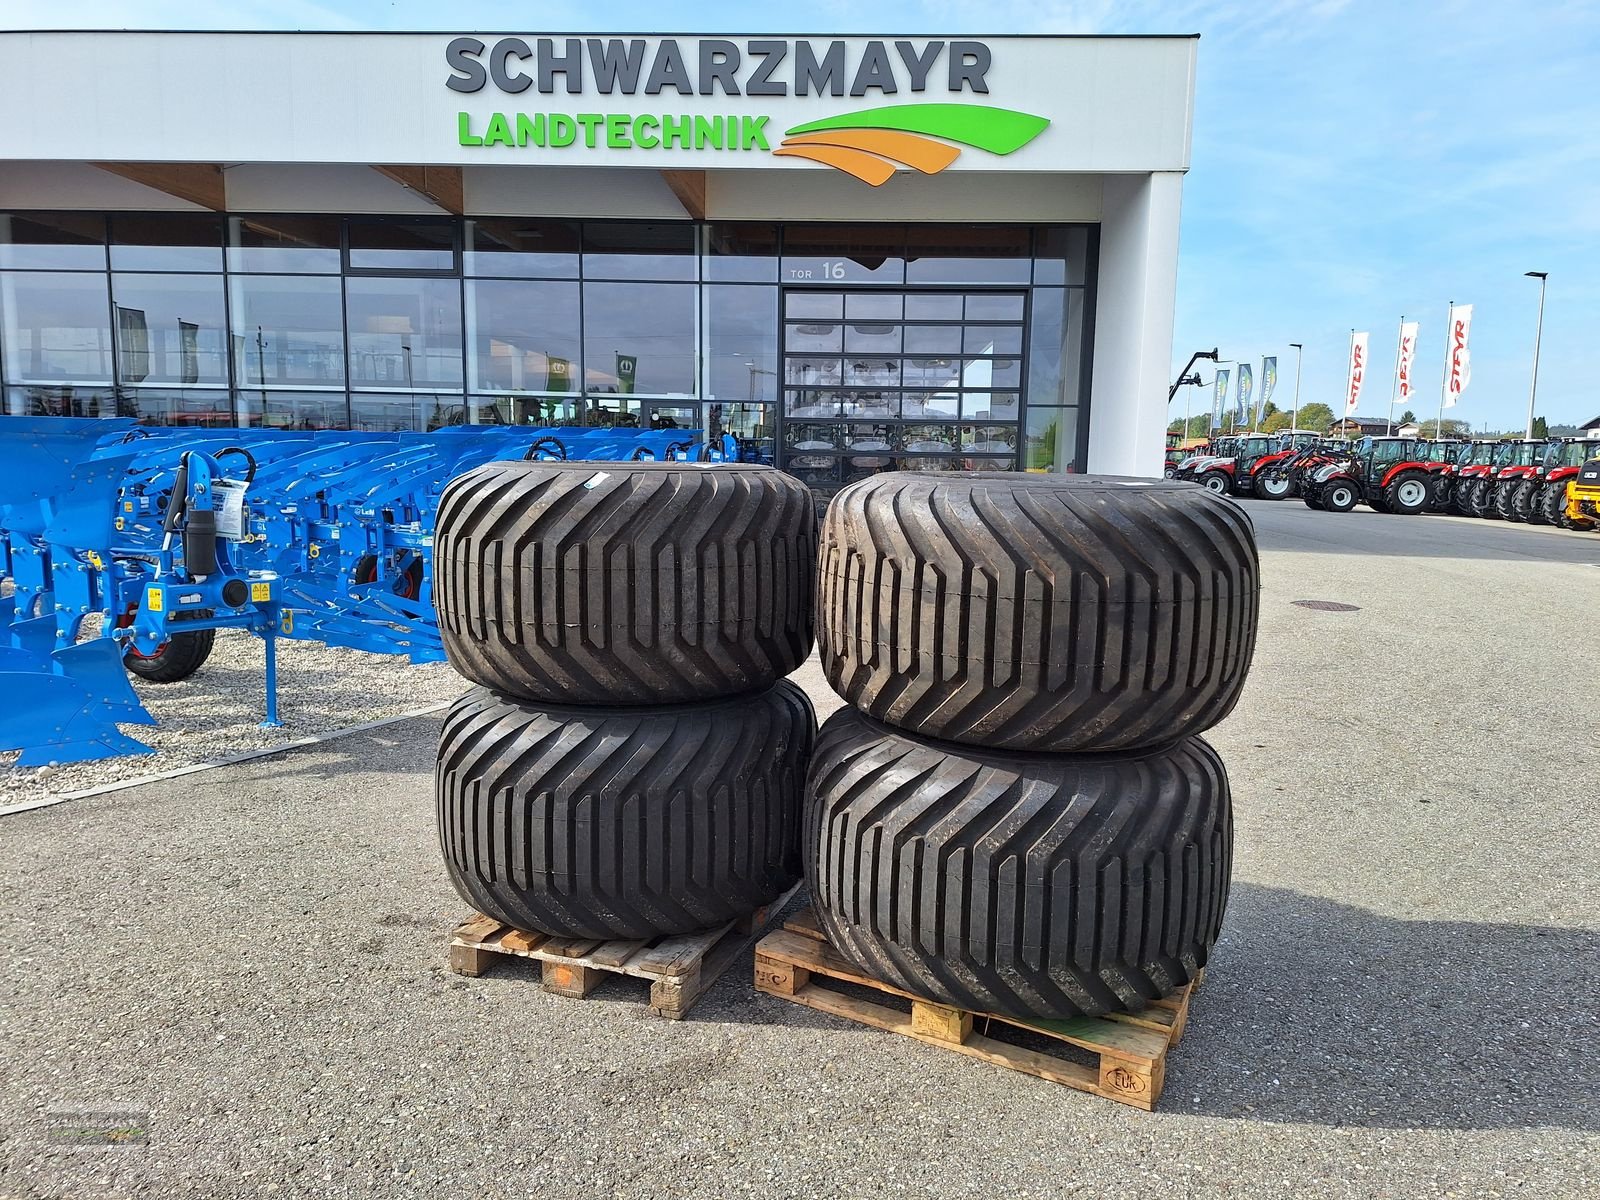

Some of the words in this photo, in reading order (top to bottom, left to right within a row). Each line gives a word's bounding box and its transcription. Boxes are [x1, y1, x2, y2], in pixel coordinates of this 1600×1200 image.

[445, 37, 992, 97] SCHWARZMAYR
[458, 112, 771, 151] LANDTECHNIK
[791, 270, 812, 279] TOR
[823, 262, 845, 279] 16
